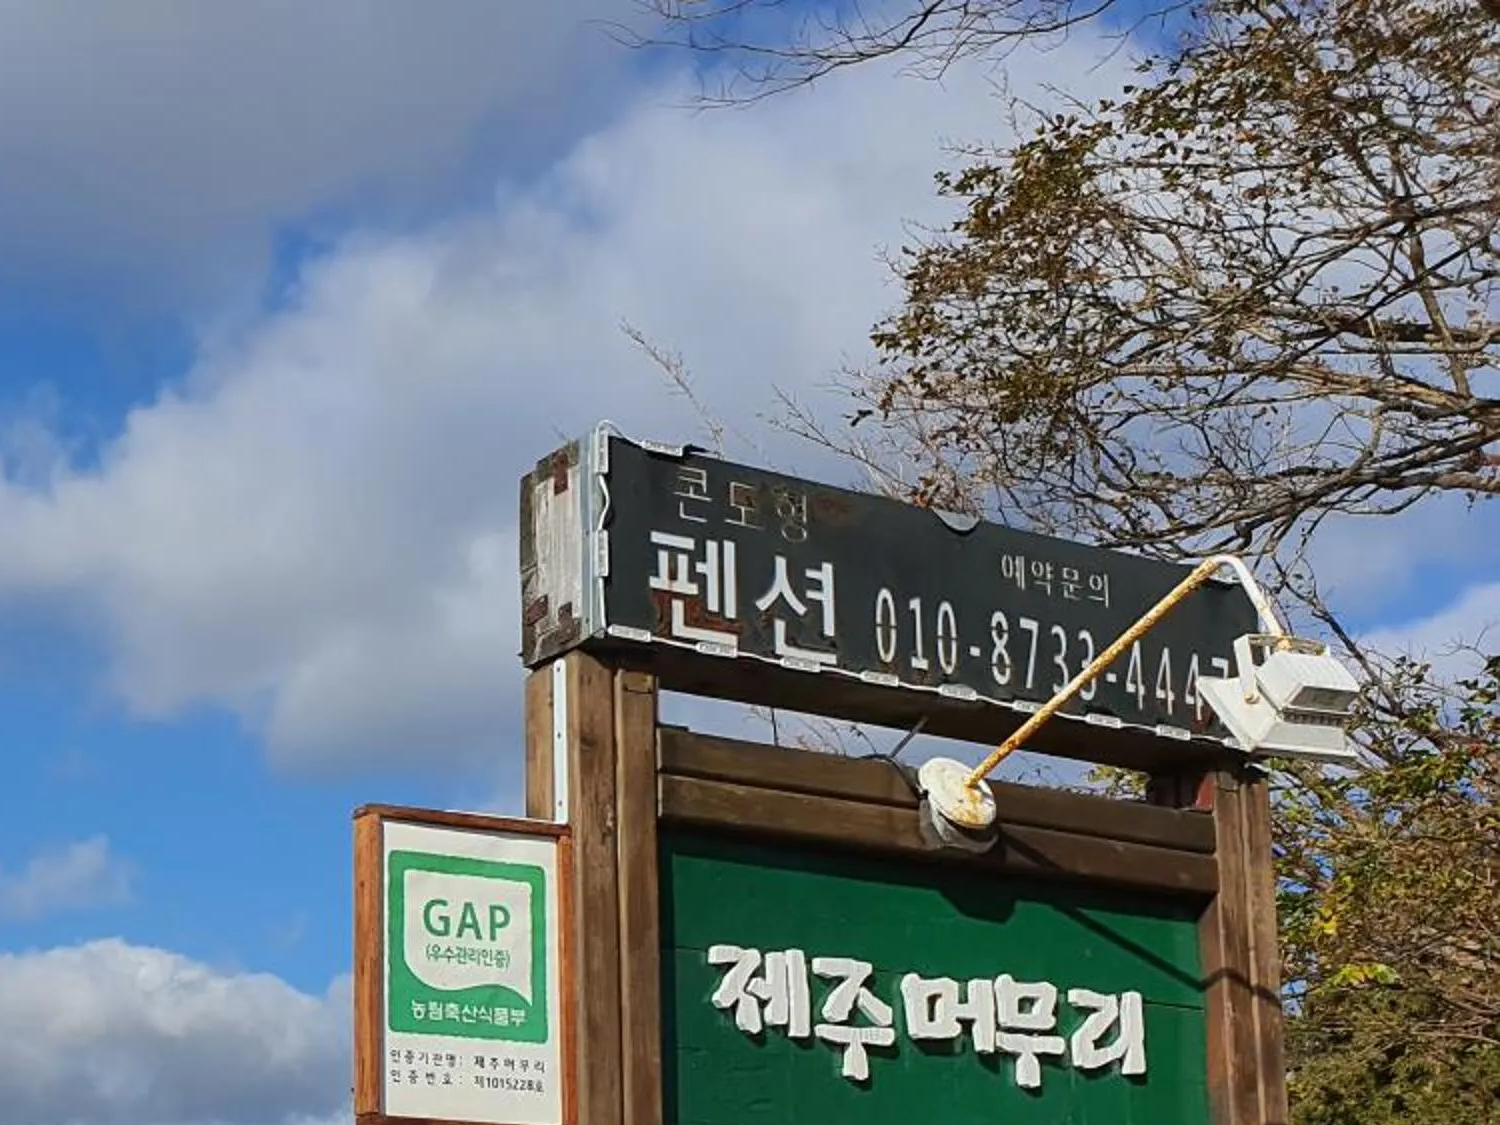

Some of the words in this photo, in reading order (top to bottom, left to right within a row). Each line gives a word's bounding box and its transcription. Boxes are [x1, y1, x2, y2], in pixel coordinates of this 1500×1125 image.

[672, 465, 808, 542] 콘도형
[649, 530, 838, 665] 펜션
[1001, 554, 1110, 608] 예약문의
[422, 898, 512, 942] GAP
[425, 945, 511, 970] (우수관리인증)
[411, 999, 527, 1027] 농림축산식품부
[707, 944, 1147, 1089] 제주머무리
[473, 1054, 546, 1074] 제주머무리
